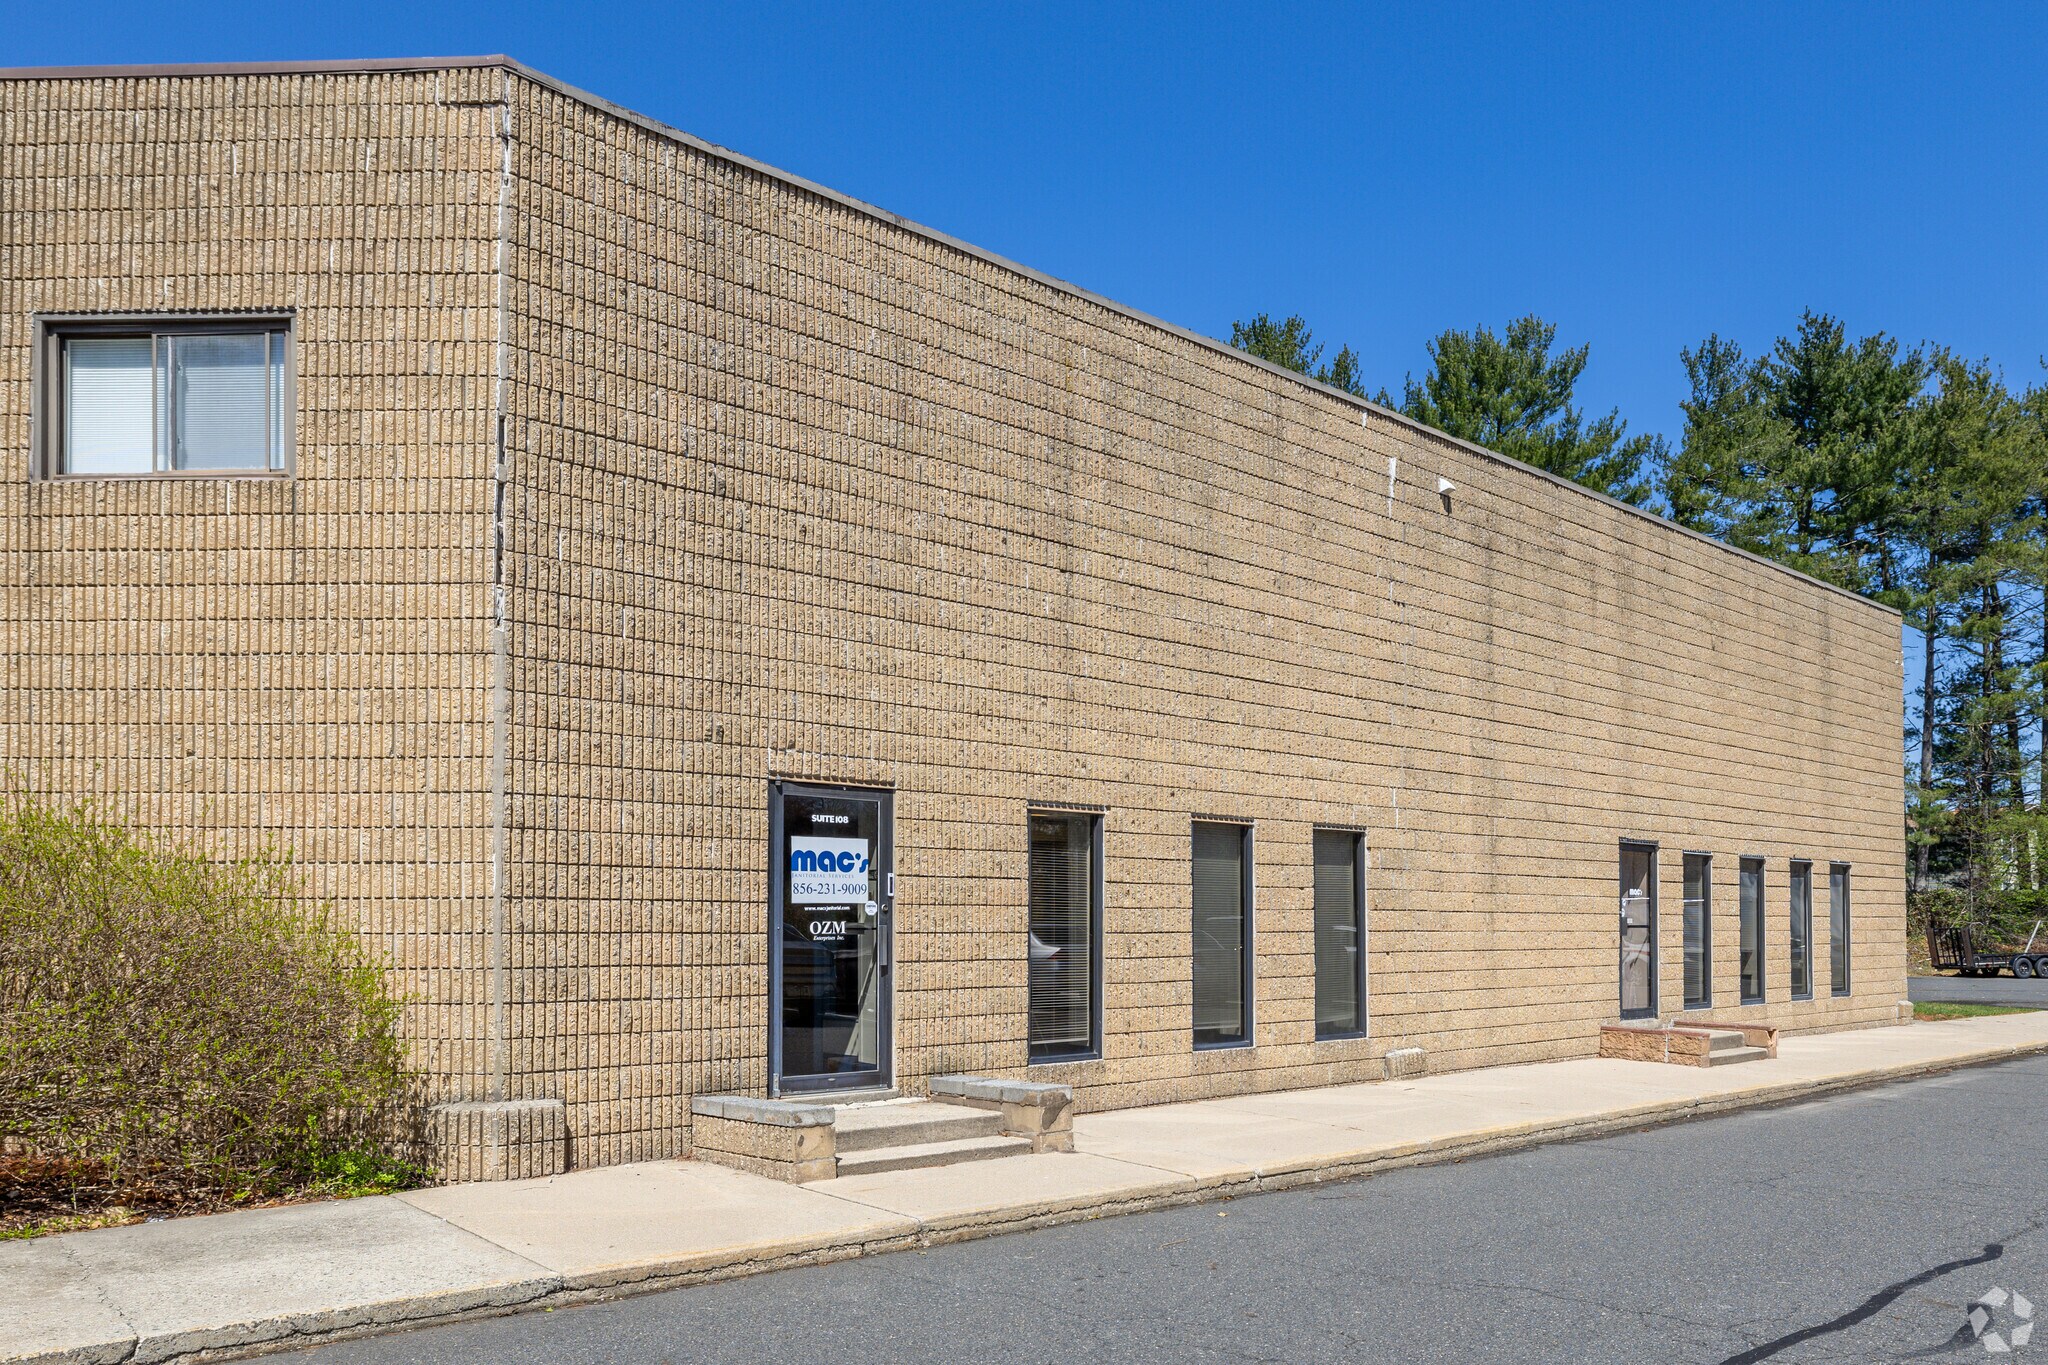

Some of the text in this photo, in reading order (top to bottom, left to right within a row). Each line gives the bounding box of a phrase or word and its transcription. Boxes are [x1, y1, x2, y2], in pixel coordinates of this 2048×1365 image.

[812, 814, 848, 824] SUITE 108
[791, 849, 869, 873] mac's
[792, 882, 868, 895] 856-231-9009
[809, 920, 847, 935] OZM
